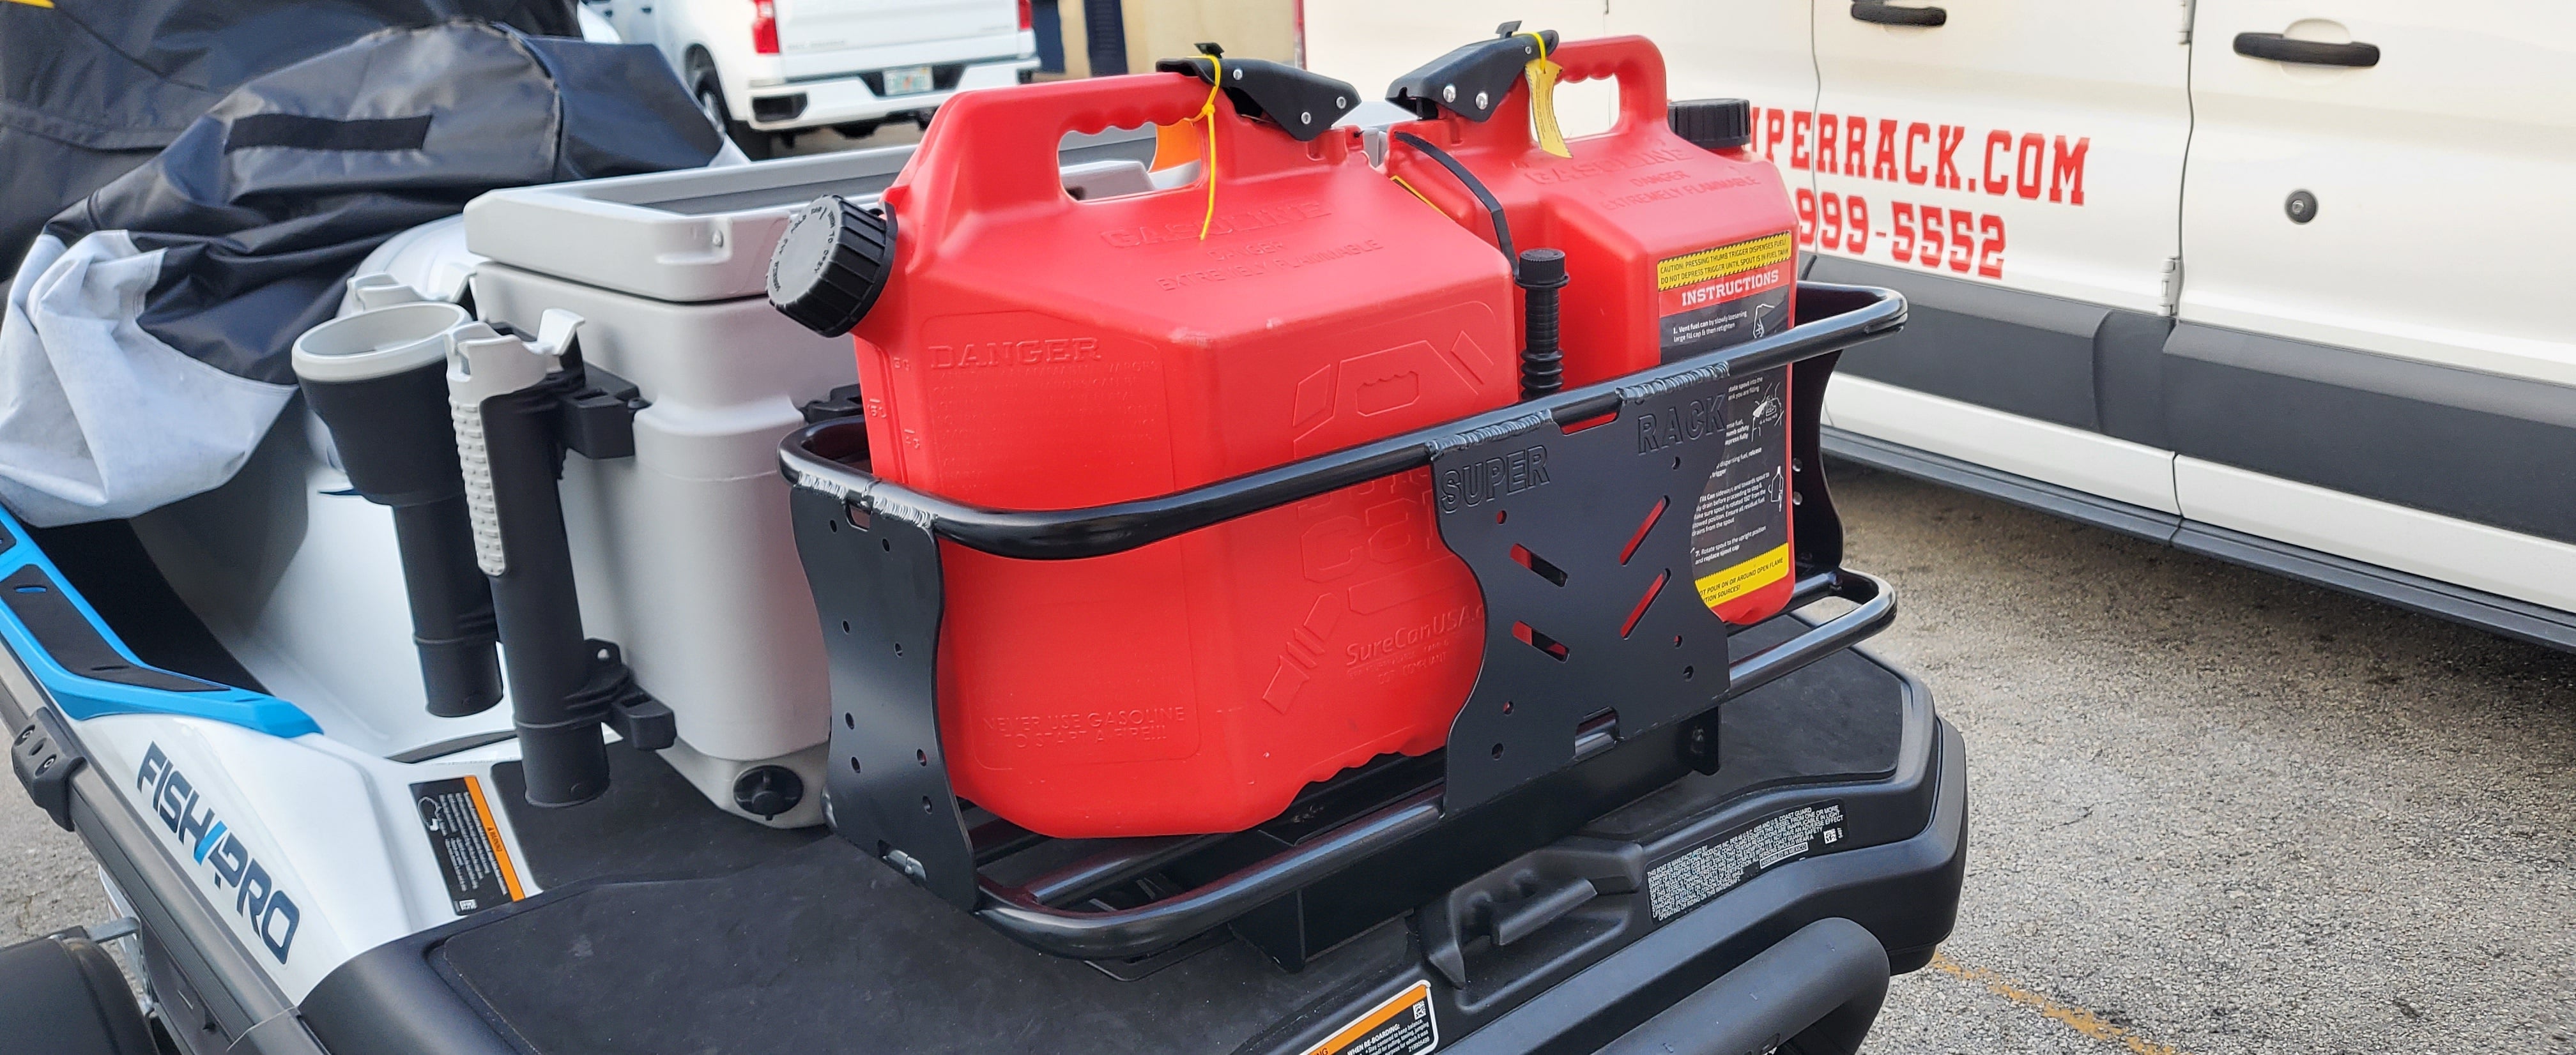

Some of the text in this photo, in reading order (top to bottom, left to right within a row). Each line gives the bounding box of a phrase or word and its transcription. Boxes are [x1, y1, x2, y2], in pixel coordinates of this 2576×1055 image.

[1752, 107, 2090, 206] PERRACK.COM
[1630, 170, 1691, 187] DANGER
[1601, 175, 1763, 211] EXTREMELY FLAMMABLE
[1207, 241, 1285, 262] DANGER
[1685, 257, 1710, 268] PRESSING
[1710, 252, 1728, 262] THUMB
[1729, 248, 1749, 258] TRIGGER
[1749, 242, 1774, 254] DISPENSES
[1155, 239, 1384, 291] EXTREMELY FLAMMABLE
[1682, 269, 1703, 279] DEPRESS
[1705, 264, 1724, 274] TRIGGER
[1726, 260, 1739, 269] UNTIL
[1740, 256, 1755, 266] SPOUT
[1682, 269, 1779, 307] INSTRUCTIONS
[1678, 324, 1690, 333] Vent
[1690, 321, 1699, 330] fuel
[1714, 315, 1728, 324] slowly
[1674, 334, 1685, 343] large
[928, 337, 1101, 368] DANGER
[1738, 381, 1750, 390] spout
[1637, 392, 1726, 456] RACK
[1736, 424, 1749, 434] safety
[1739, 432, 1749, 441] fully
[1720, 447, 1762, 468] dispensing release
[1441, 444, 1551, 514] SUPER
[1712, 467, 1727, 478] trigger
[1702, 501, 1713, 510] drain
[1713, 496, 1726, 506] before
[1726, 489, 1747, 502] proceeding
[1706, 492, 1715, 500] Can
[1715, 485, 1733, 497] sideways
[1713, 505, 1725, 514] spout
[1729, 497, 1743, 508] rotated
[1751, 491, 1759, 499] from
[1725, 507, 1738, 517] Ensure
[1744, 500, 1758, 510] residual
[1692, 526, 1705, 537] drains
[1705, 523, 1716, 532] from
[1723, 517, 1735, 527] spout
[1701, 545, 1715, 556] Rotate
[1715, 542, 1726, 550] spout
[1738, 531, 1752, 543] upright
[1752, 526, 1766, 536] position
[1703, 551, 1719, 563] replace
[1720, 547, 1731, 557] spout
[1707, 583, 1721, 594] POUR
[1737, 570, 1756, 582] AROUND
[1757, 564, 1768, 573] OPEN
[1770, 558, 1783, 568] FLAME
[1717, 584, 1740, 598] SOURCES!
[982, 706, 1185, 732] NEVER USE GASOLINE
[1004, 732, 1029, 748] TO
[1035, 730, 1088, 748] START
[1094, 729, 1105, 743] A
[1774, 819, 1790, 830] VESSEL
[1790, 814, 1804, 823] FROM
[1779, 812, 1794, 822] COAST
[1795, 807, 1812, 816] GUARD
[1787, 816, 1820, 830] INAPPLICABLE
[1773, 826, 1823, 847] COAST GUARD SAFETY
[1782, 829, 1795, 838] HAVE
[1802, 821, 1825, 831] ADVERSE
[1759, 847, 1777, 858] PERSONS
[1777, 840, 1795, 851] SHOULD
[1795, 835, 1810, 844] WEAR
[1762, 853, 1784, 865] ASSEMBLED
[1789, 844, 1805, 854] MEXICO
[1347, 1024, 1400, 1055] WHEN RE-BOARDING:
[1399, 1028, 1407, 1037] keep
[1406, 1036, 1417, 1045] which
